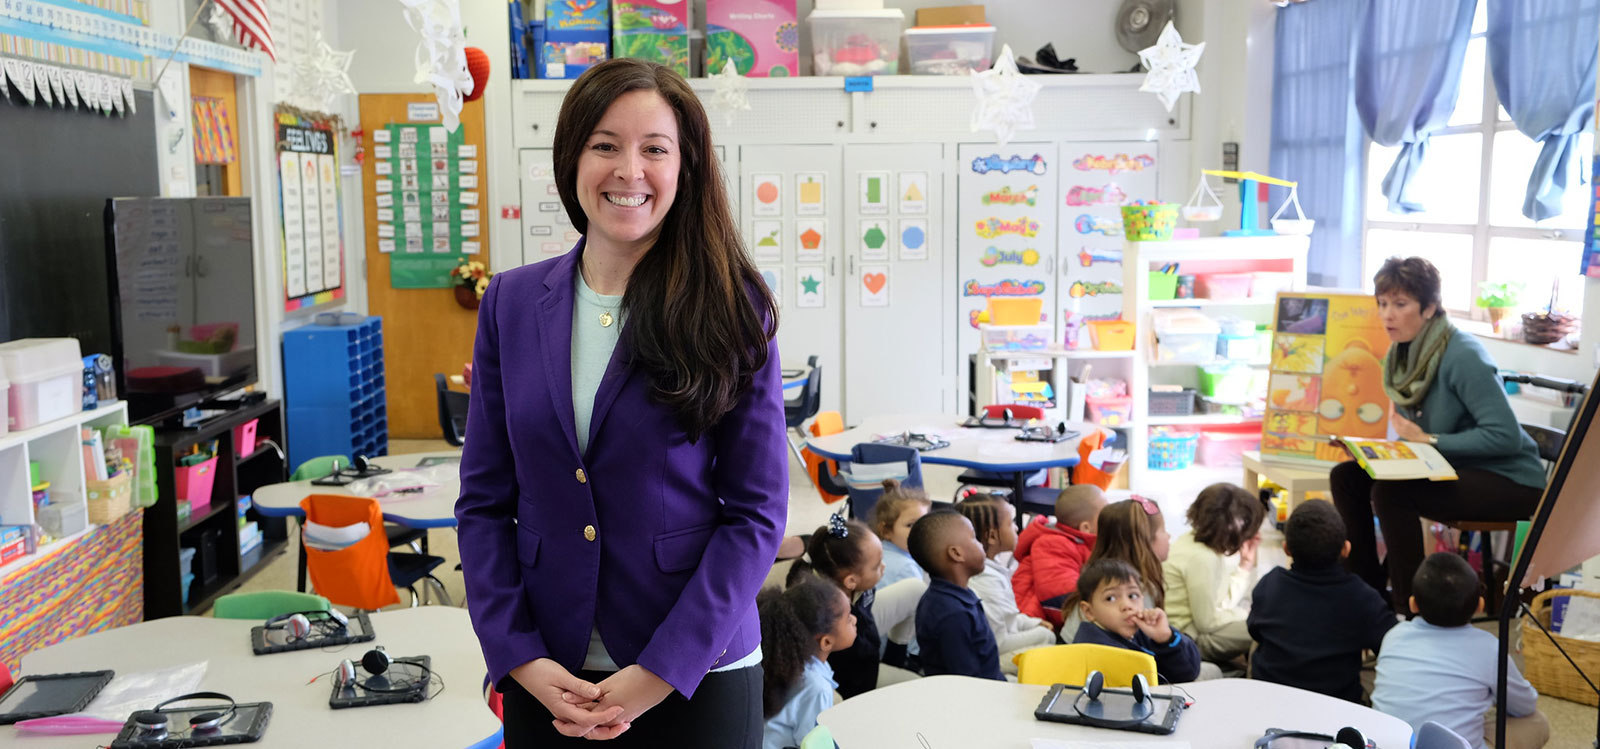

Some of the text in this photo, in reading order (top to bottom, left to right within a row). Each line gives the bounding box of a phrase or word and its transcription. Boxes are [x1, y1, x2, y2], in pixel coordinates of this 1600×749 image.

[286, 128, 328, 153] FEELINGS
[989, 191, 1028, 204] March
[999, 221, 1026, 235] May
[999, 250, 1023, 264] July
